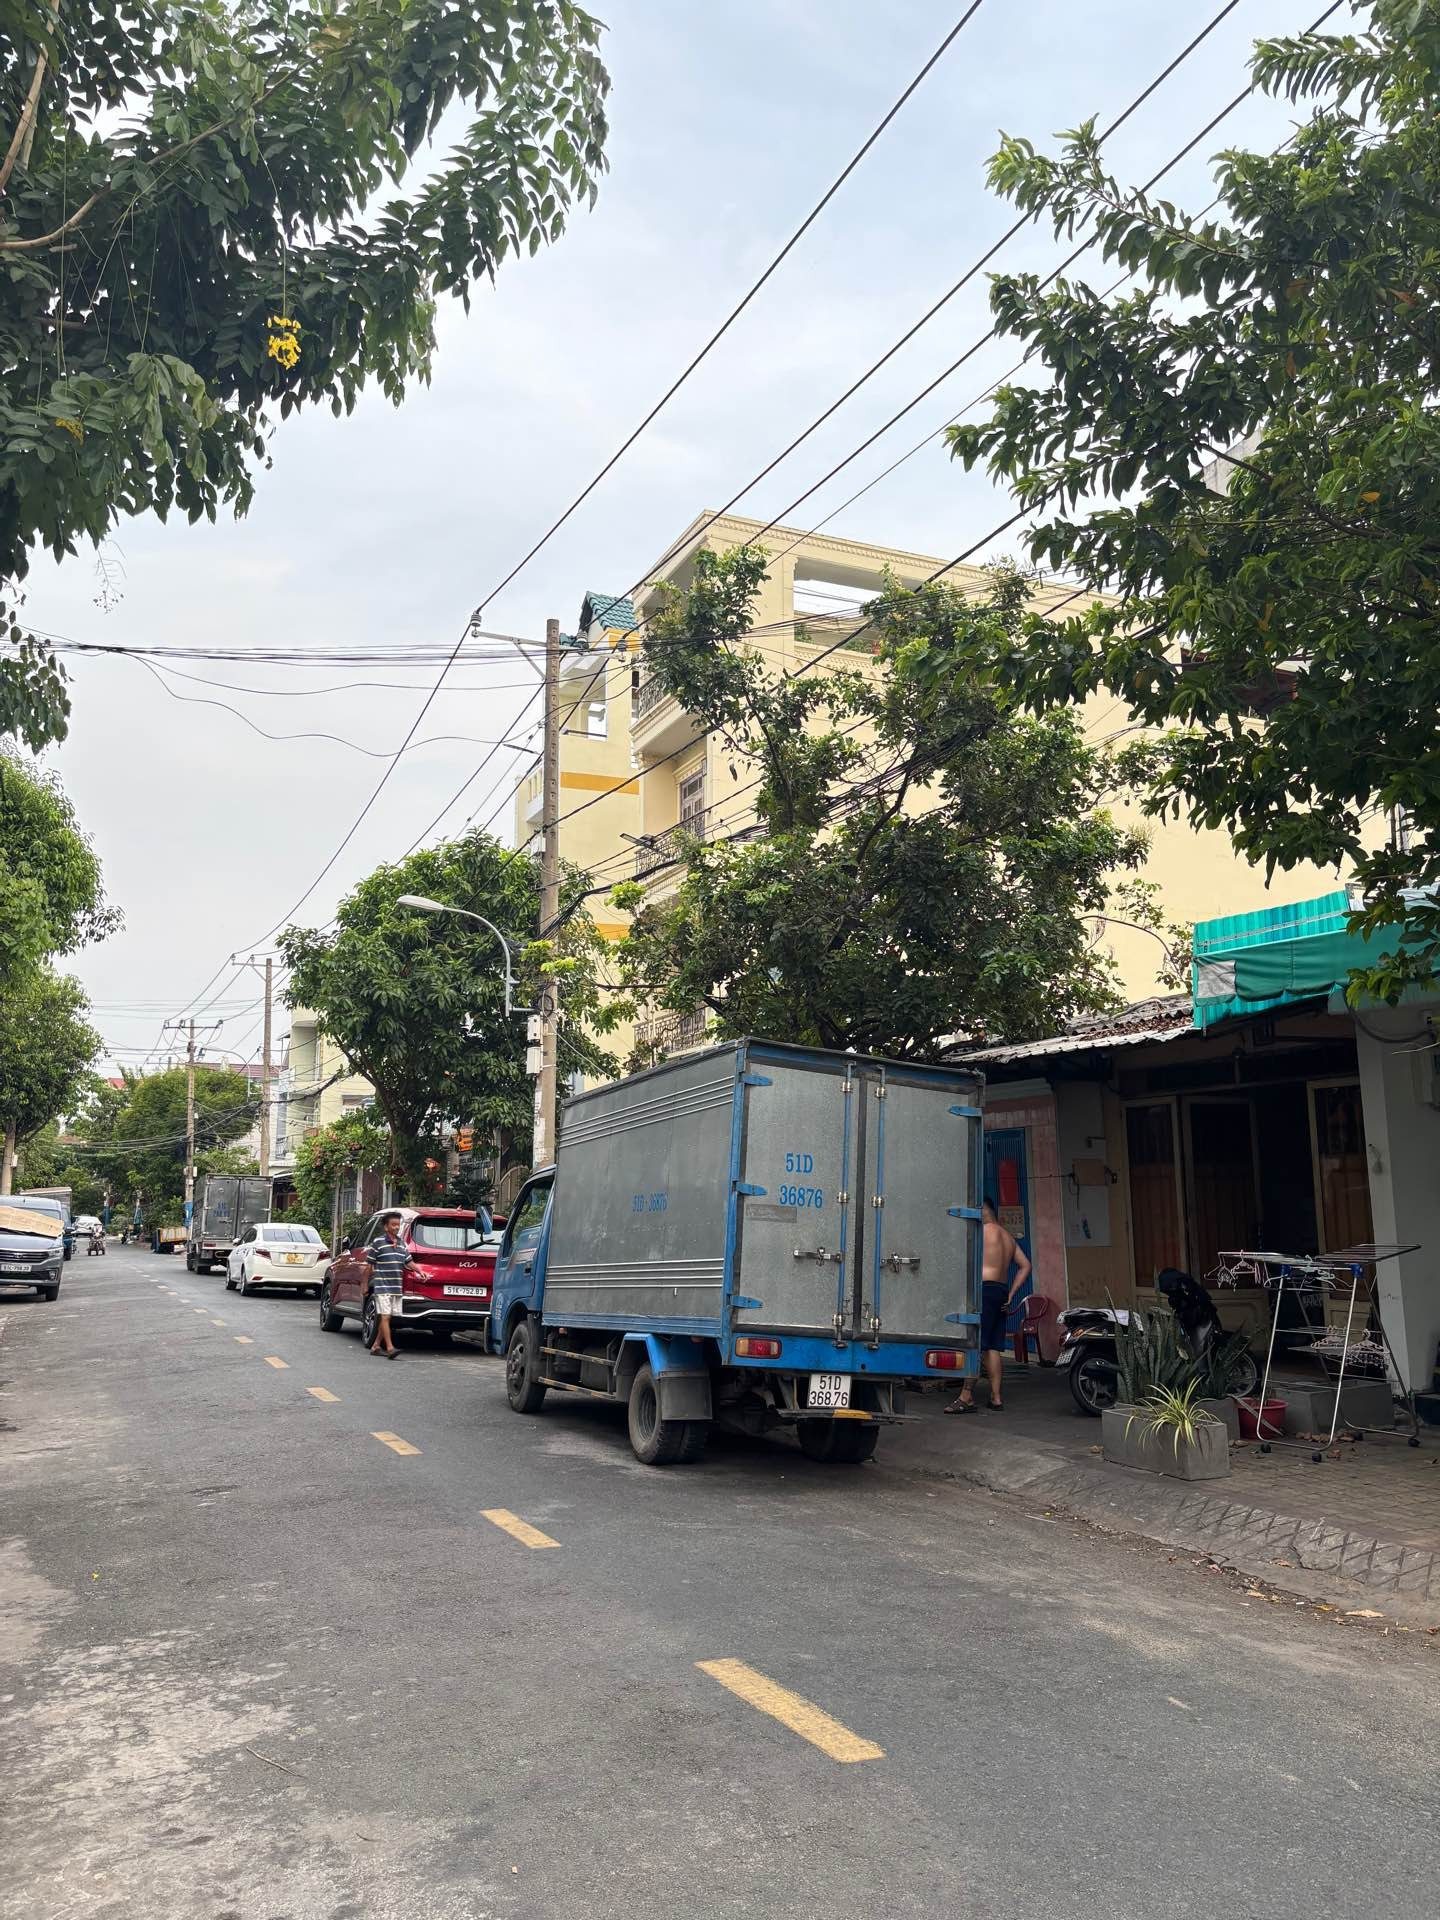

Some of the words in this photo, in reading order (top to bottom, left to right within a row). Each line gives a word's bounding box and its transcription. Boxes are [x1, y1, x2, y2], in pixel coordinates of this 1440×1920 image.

[785, 1152, 814, 1174] 51D
[779, 1185, 823, 1209] 36876
[819, 1375, 842, 1391] 51D
[809, 1391, 849, 1406] 368.76
